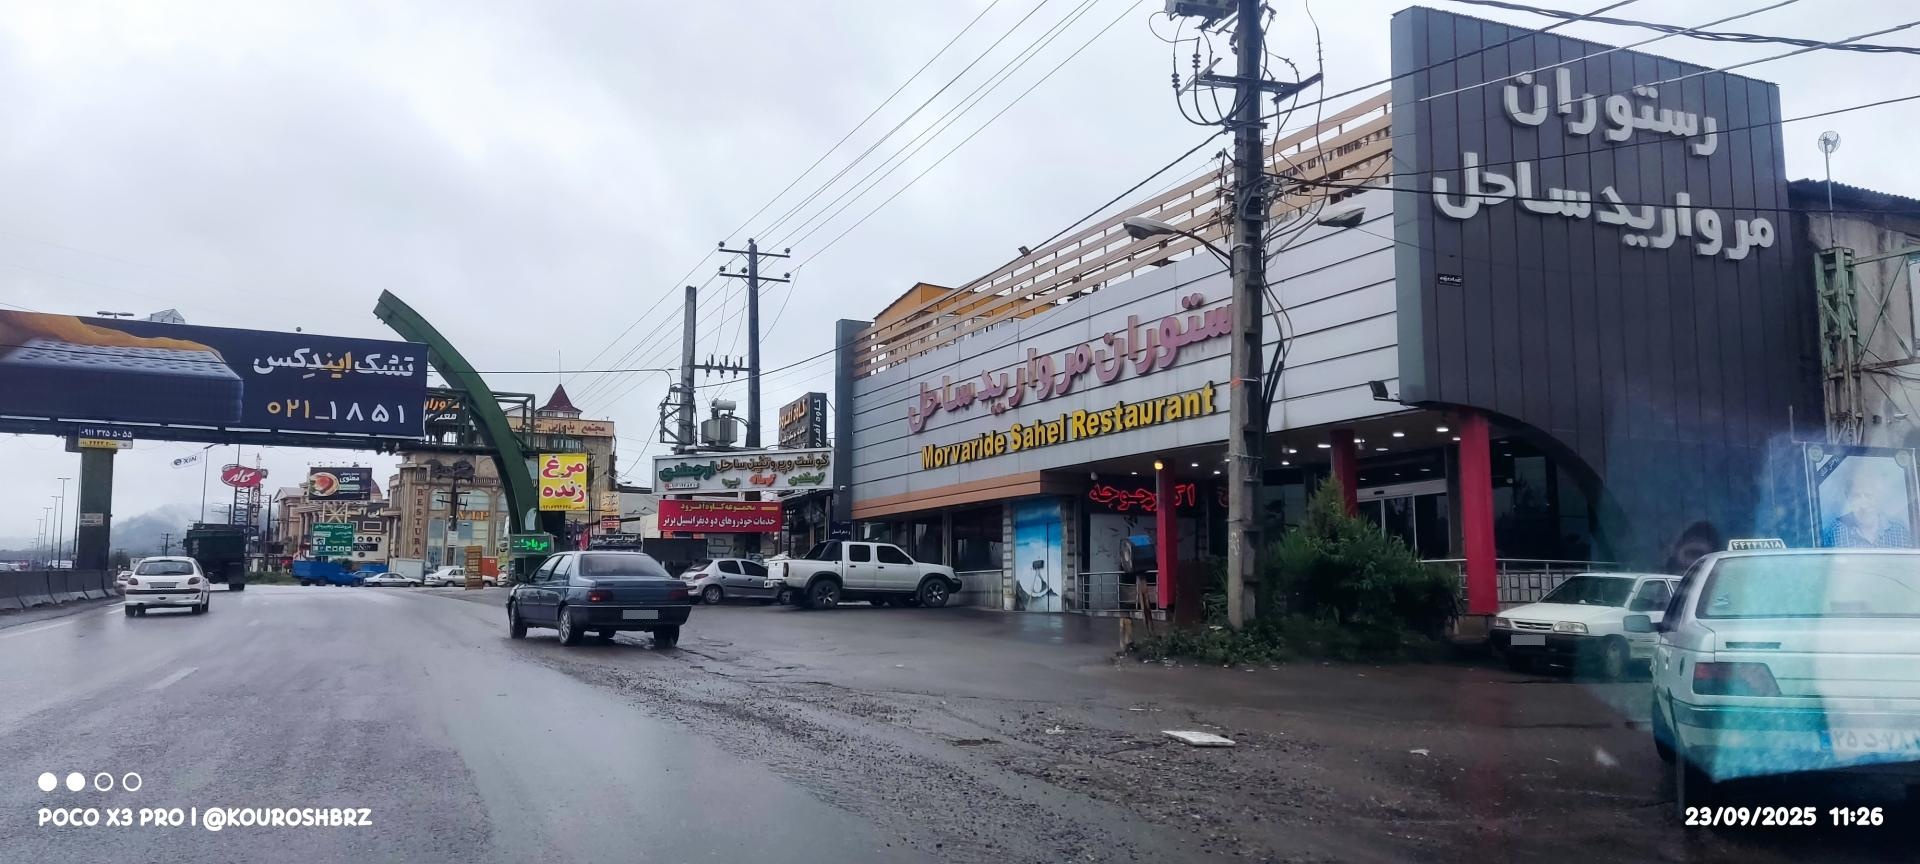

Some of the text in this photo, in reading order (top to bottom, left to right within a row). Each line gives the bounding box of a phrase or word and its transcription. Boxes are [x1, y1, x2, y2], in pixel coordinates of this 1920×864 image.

[1503, 67, 1718, 156] رستوران
[1432, 152, 1775, 260] مروارید ساحل
[354, 354, 415, 377] تشک
[908, 293, 1232, 434] ستوران مروارید ساحل
[920, 380, 1218, 470] Morvaride Sahel Restaurant
[542, 455, 585, 479] مرغ
[658, 460, 717, 480] ارجمندی
[715, 456, 748, 472] ساحل
[796, 452, 829, 471] گوشت
[542, 480, 585, 503] زنده
[663, 514, 776, 528] خدمات خودروهای دو دیفرانسیل برتر
